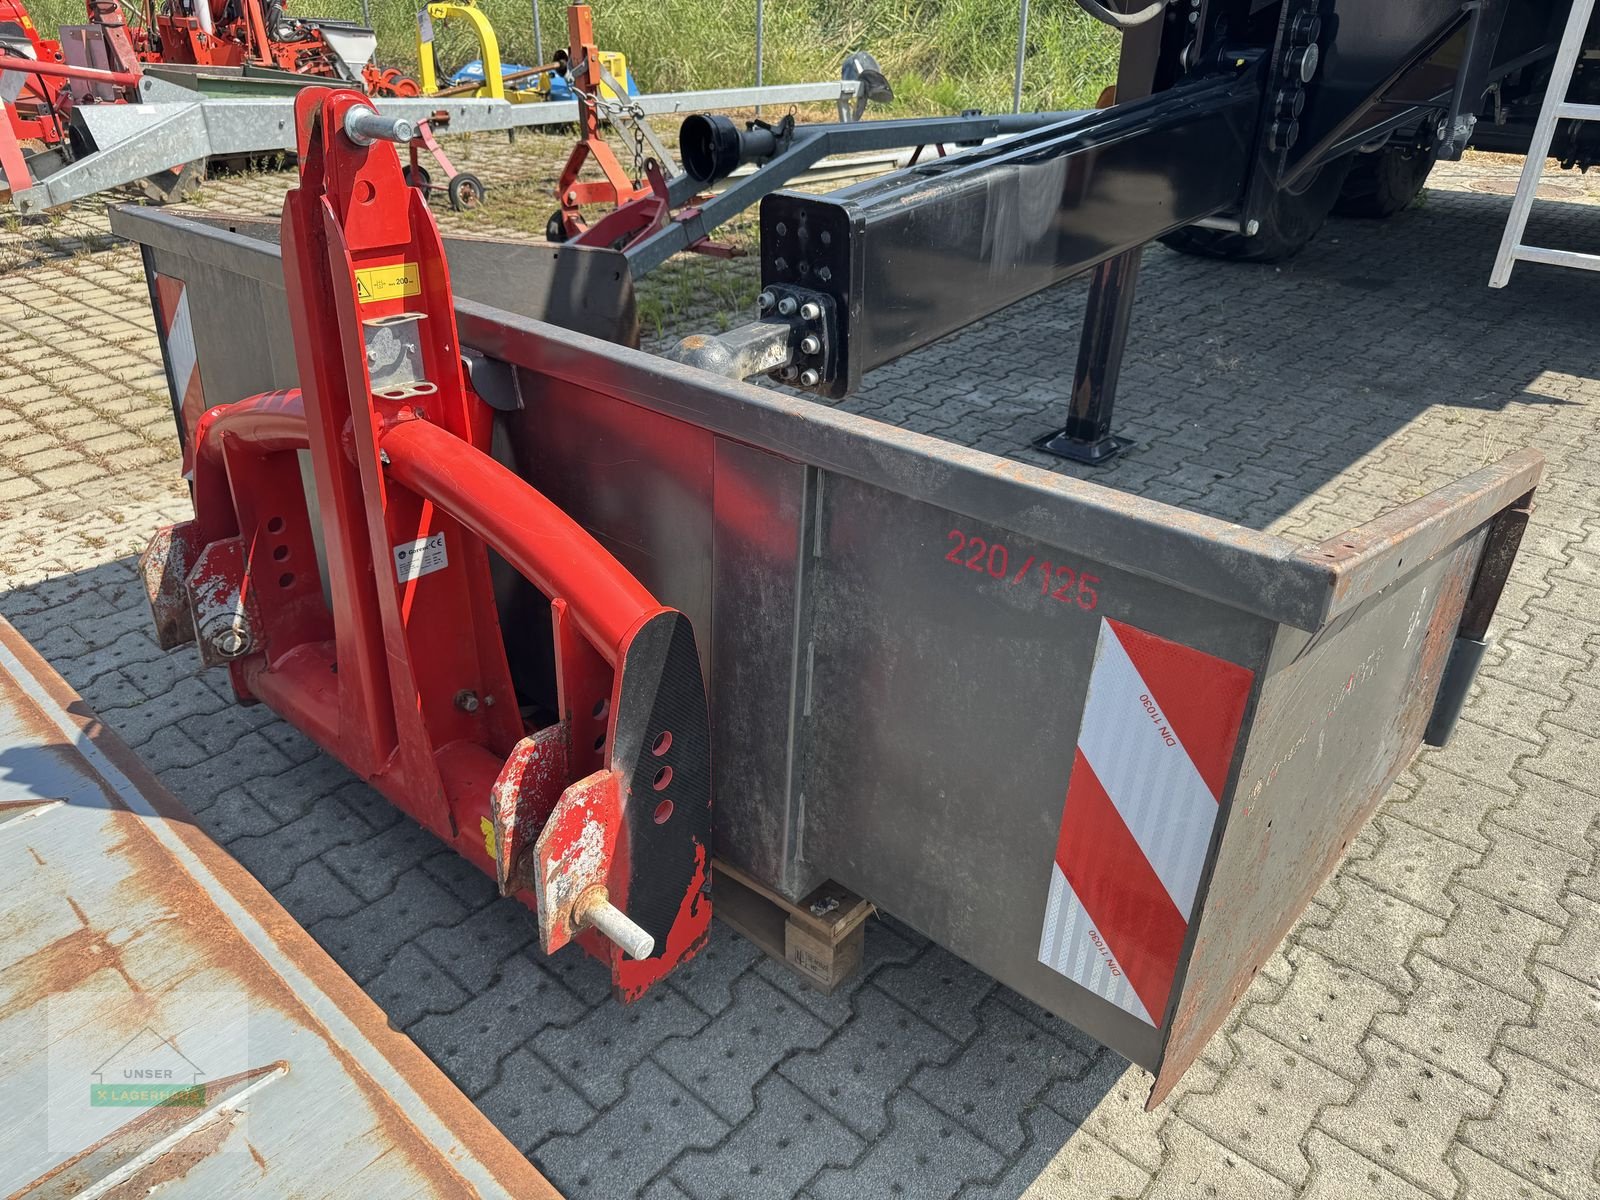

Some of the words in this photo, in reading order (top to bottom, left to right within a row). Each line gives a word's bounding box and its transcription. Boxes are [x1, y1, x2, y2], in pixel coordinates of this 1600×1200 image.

[396, 277, 409, 285] 200
[1139, 694, 1162, 724] 11030
[1158, 726, 1176, 747] DIN
[1088, 930, 1108, 956] 11030
[1106, 959, 1121, 977] DIN
